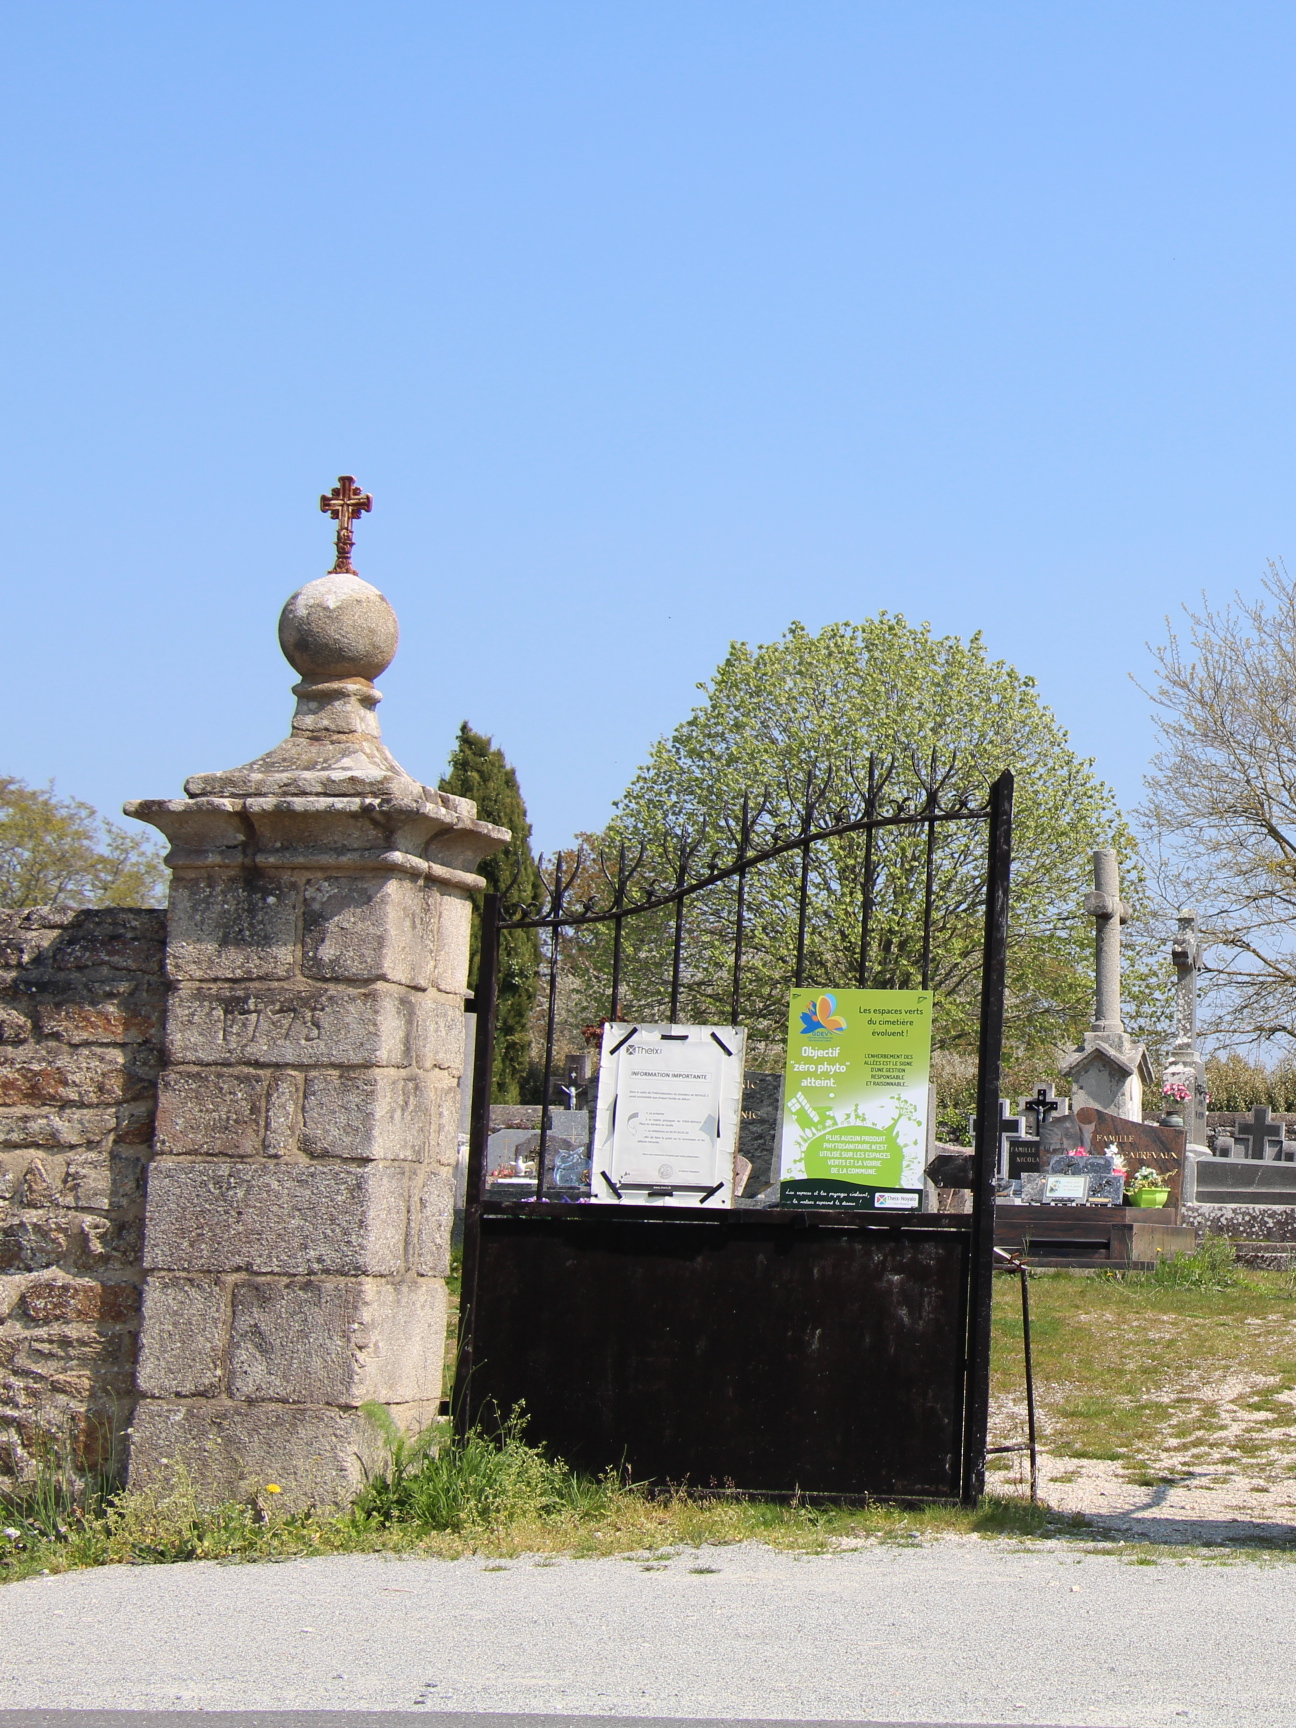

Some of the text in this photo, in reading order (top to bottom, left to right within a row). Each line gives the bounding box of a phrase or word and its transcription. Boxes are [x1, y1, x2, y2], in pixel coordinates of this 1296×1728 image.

[801, 1046, 840, 1059] Objectif
[790, 1060, 850, 1074] "zéro phyto"
[801, 1077, 837, 1087] atteint.
